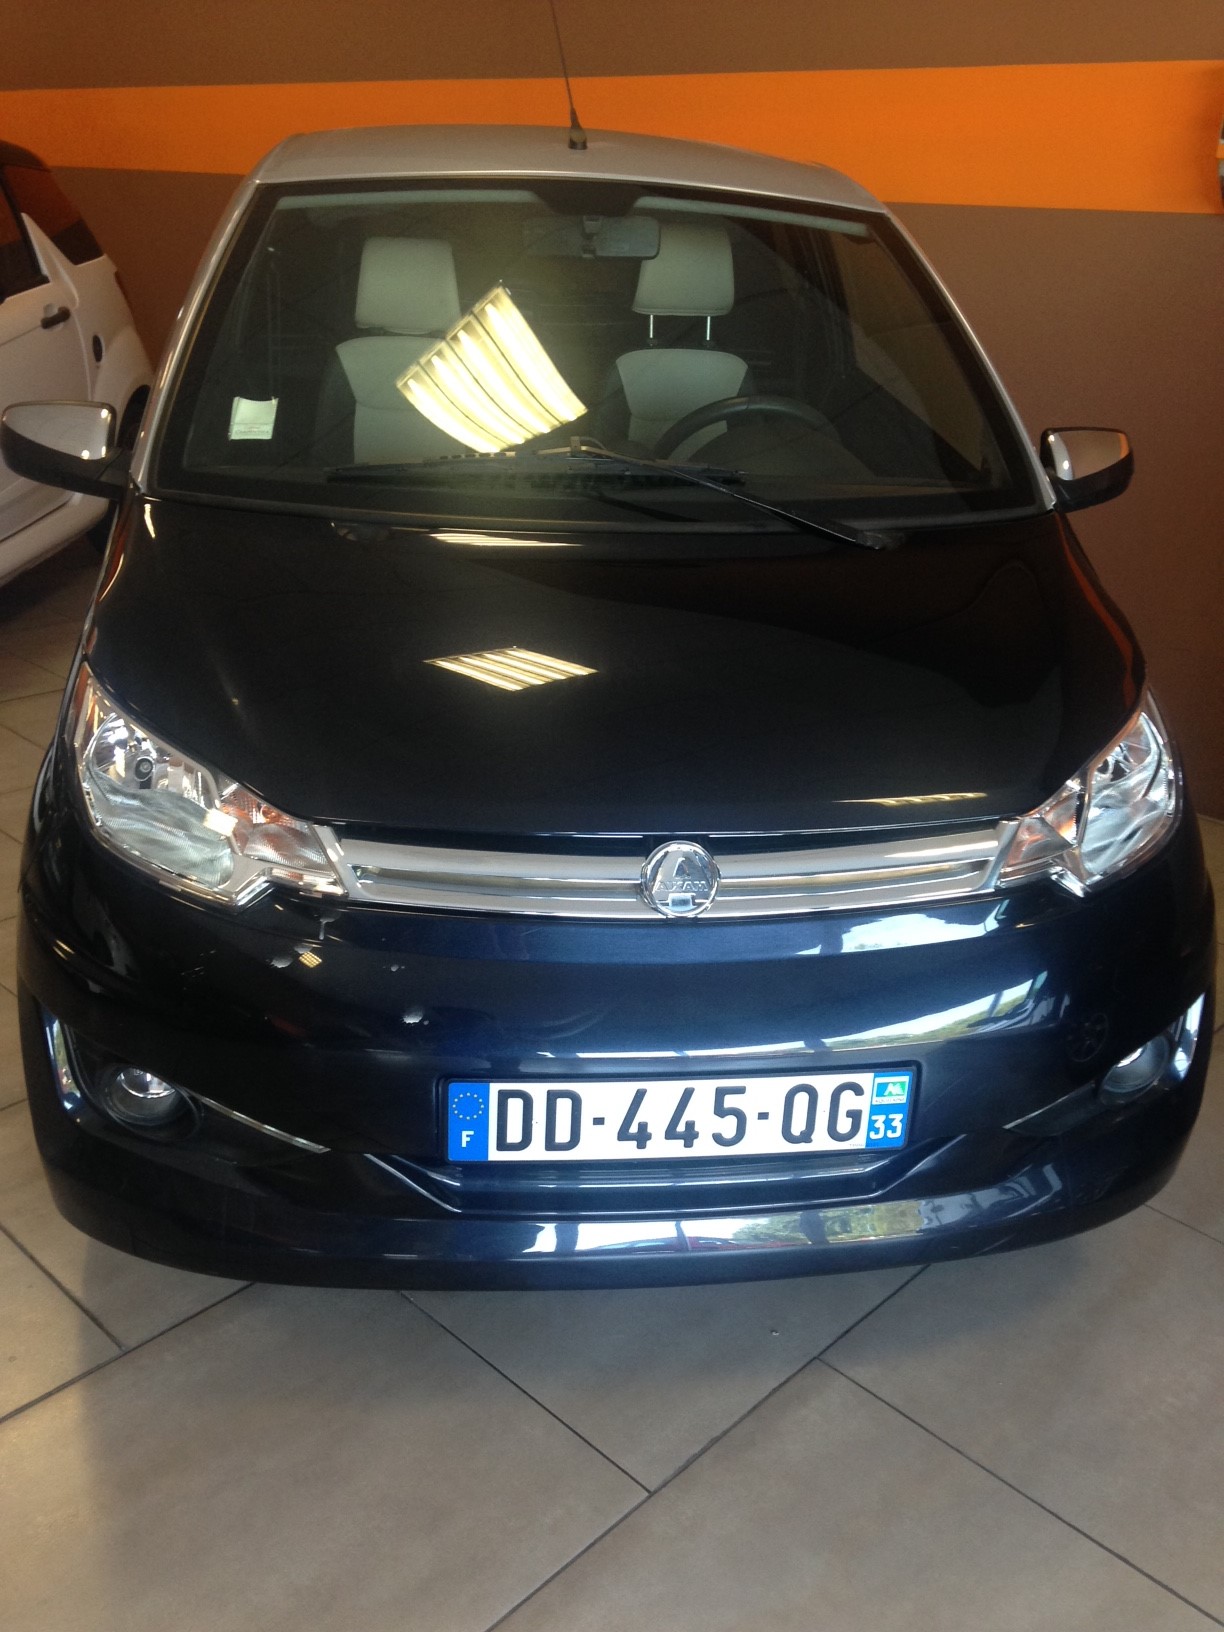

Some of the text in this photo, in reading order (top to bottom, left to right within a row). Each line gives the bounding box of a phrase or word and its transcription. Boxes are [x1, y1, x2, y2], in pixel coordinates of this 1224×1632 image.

[496, 1082, 865, 1152] DD-445-QG
[869, 1113, 903, 1139] 33
[461, 1130, 474, 1147] F
